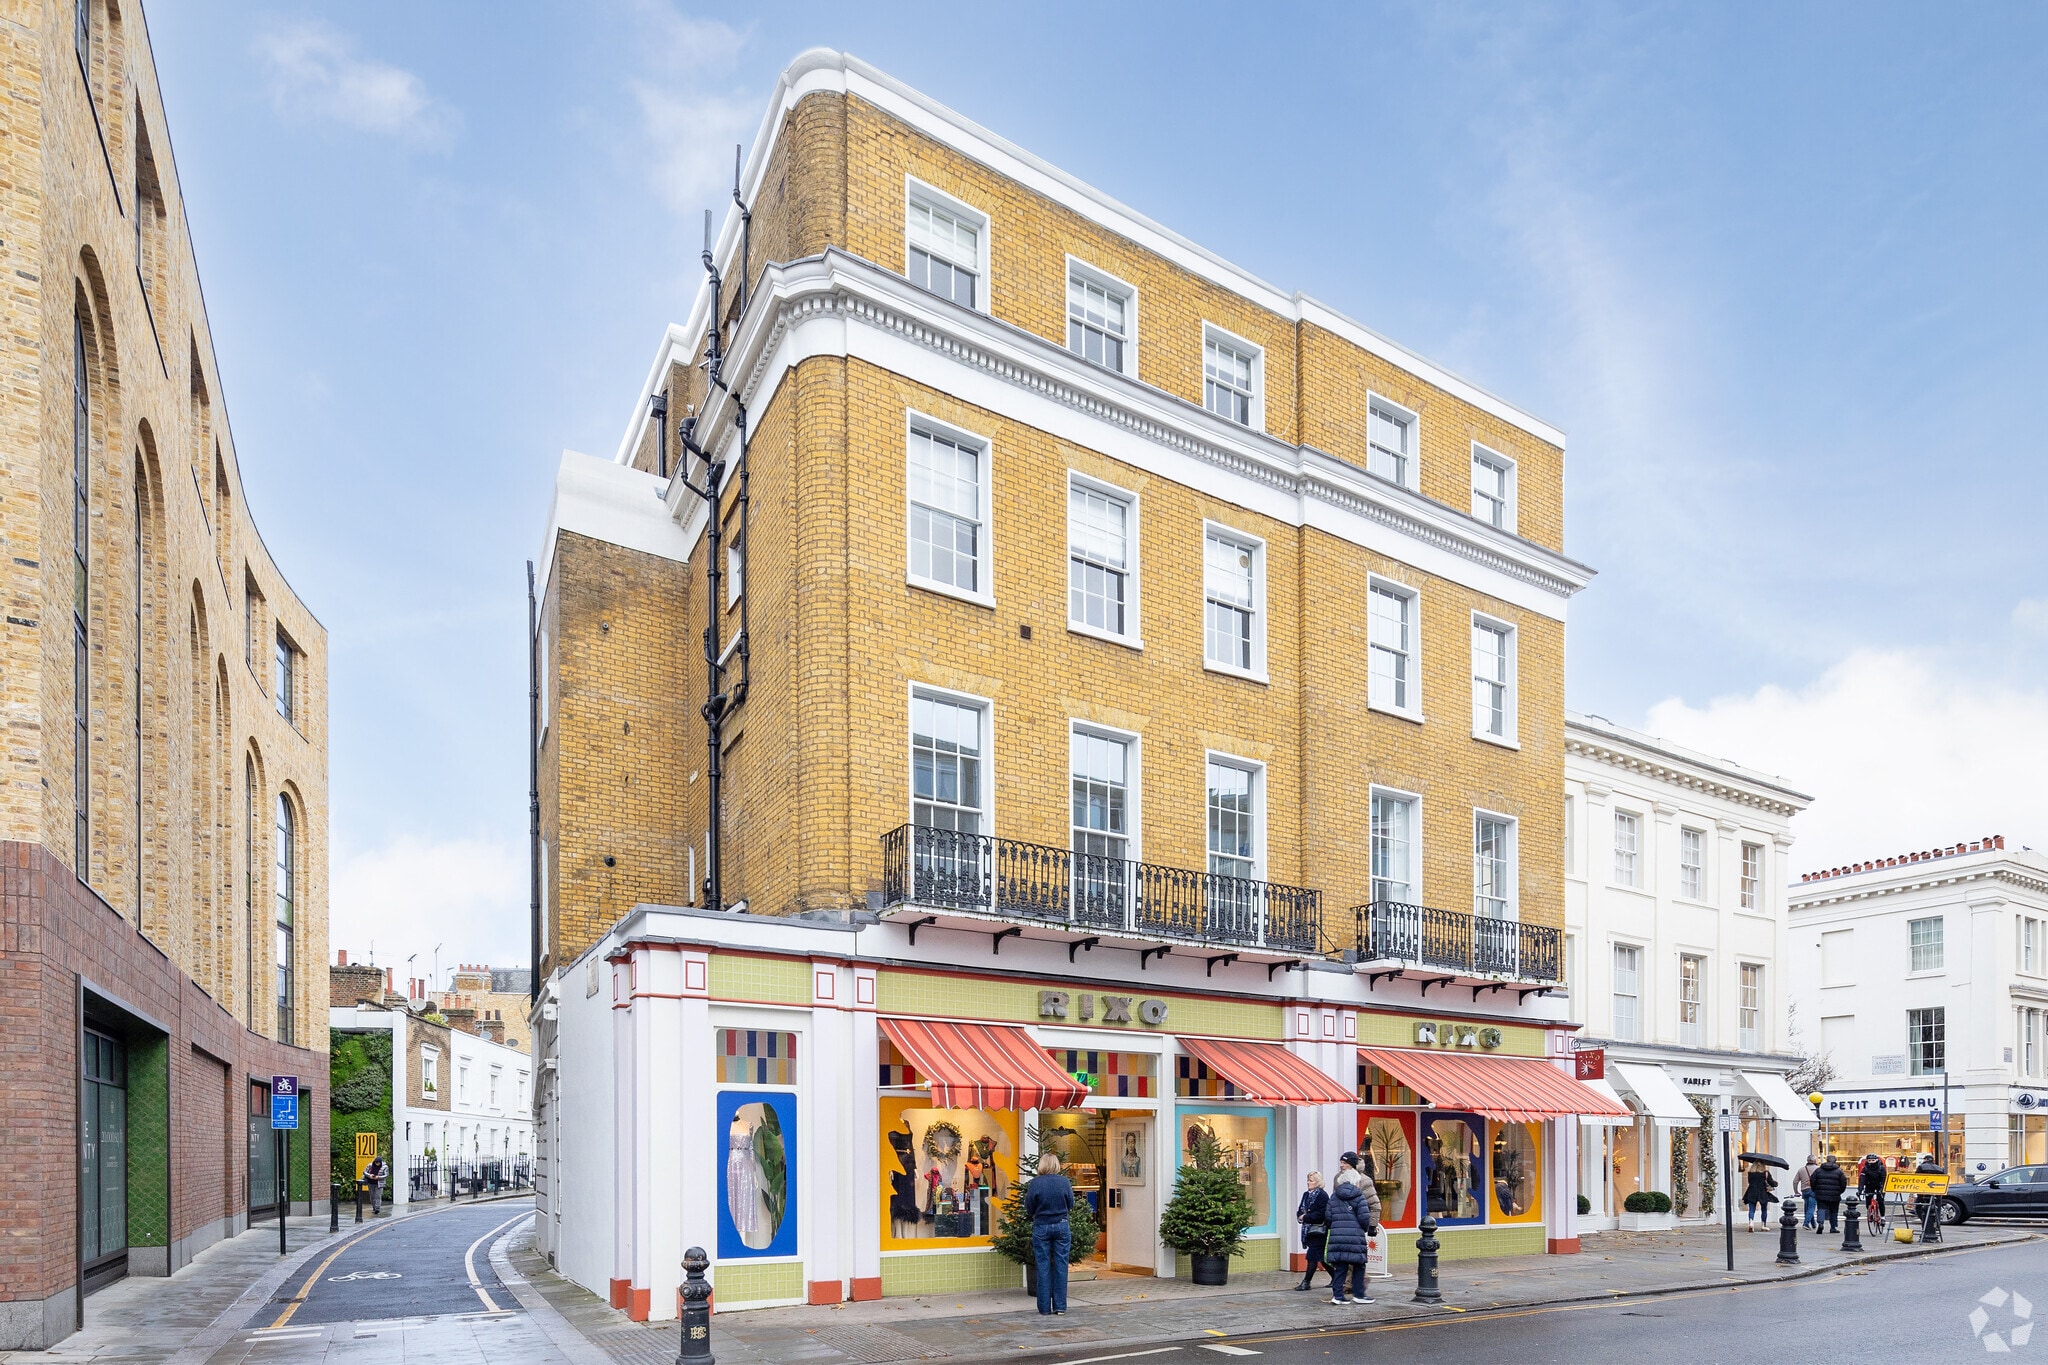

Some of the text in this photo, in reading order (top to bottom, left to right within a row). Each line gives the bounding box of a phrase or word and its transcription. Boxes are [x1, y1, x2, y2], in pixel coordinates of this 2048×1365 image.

[1038, 991, 1168, 1025] RIXO
[1413, 1022, 1502, 1048] RIXO
[1683, 1077, 1711, 1087] VARLEY
[1830, 1098, 1936, 1110] PETIT BATEAU
[357, 1135, 375, 1155] 120
